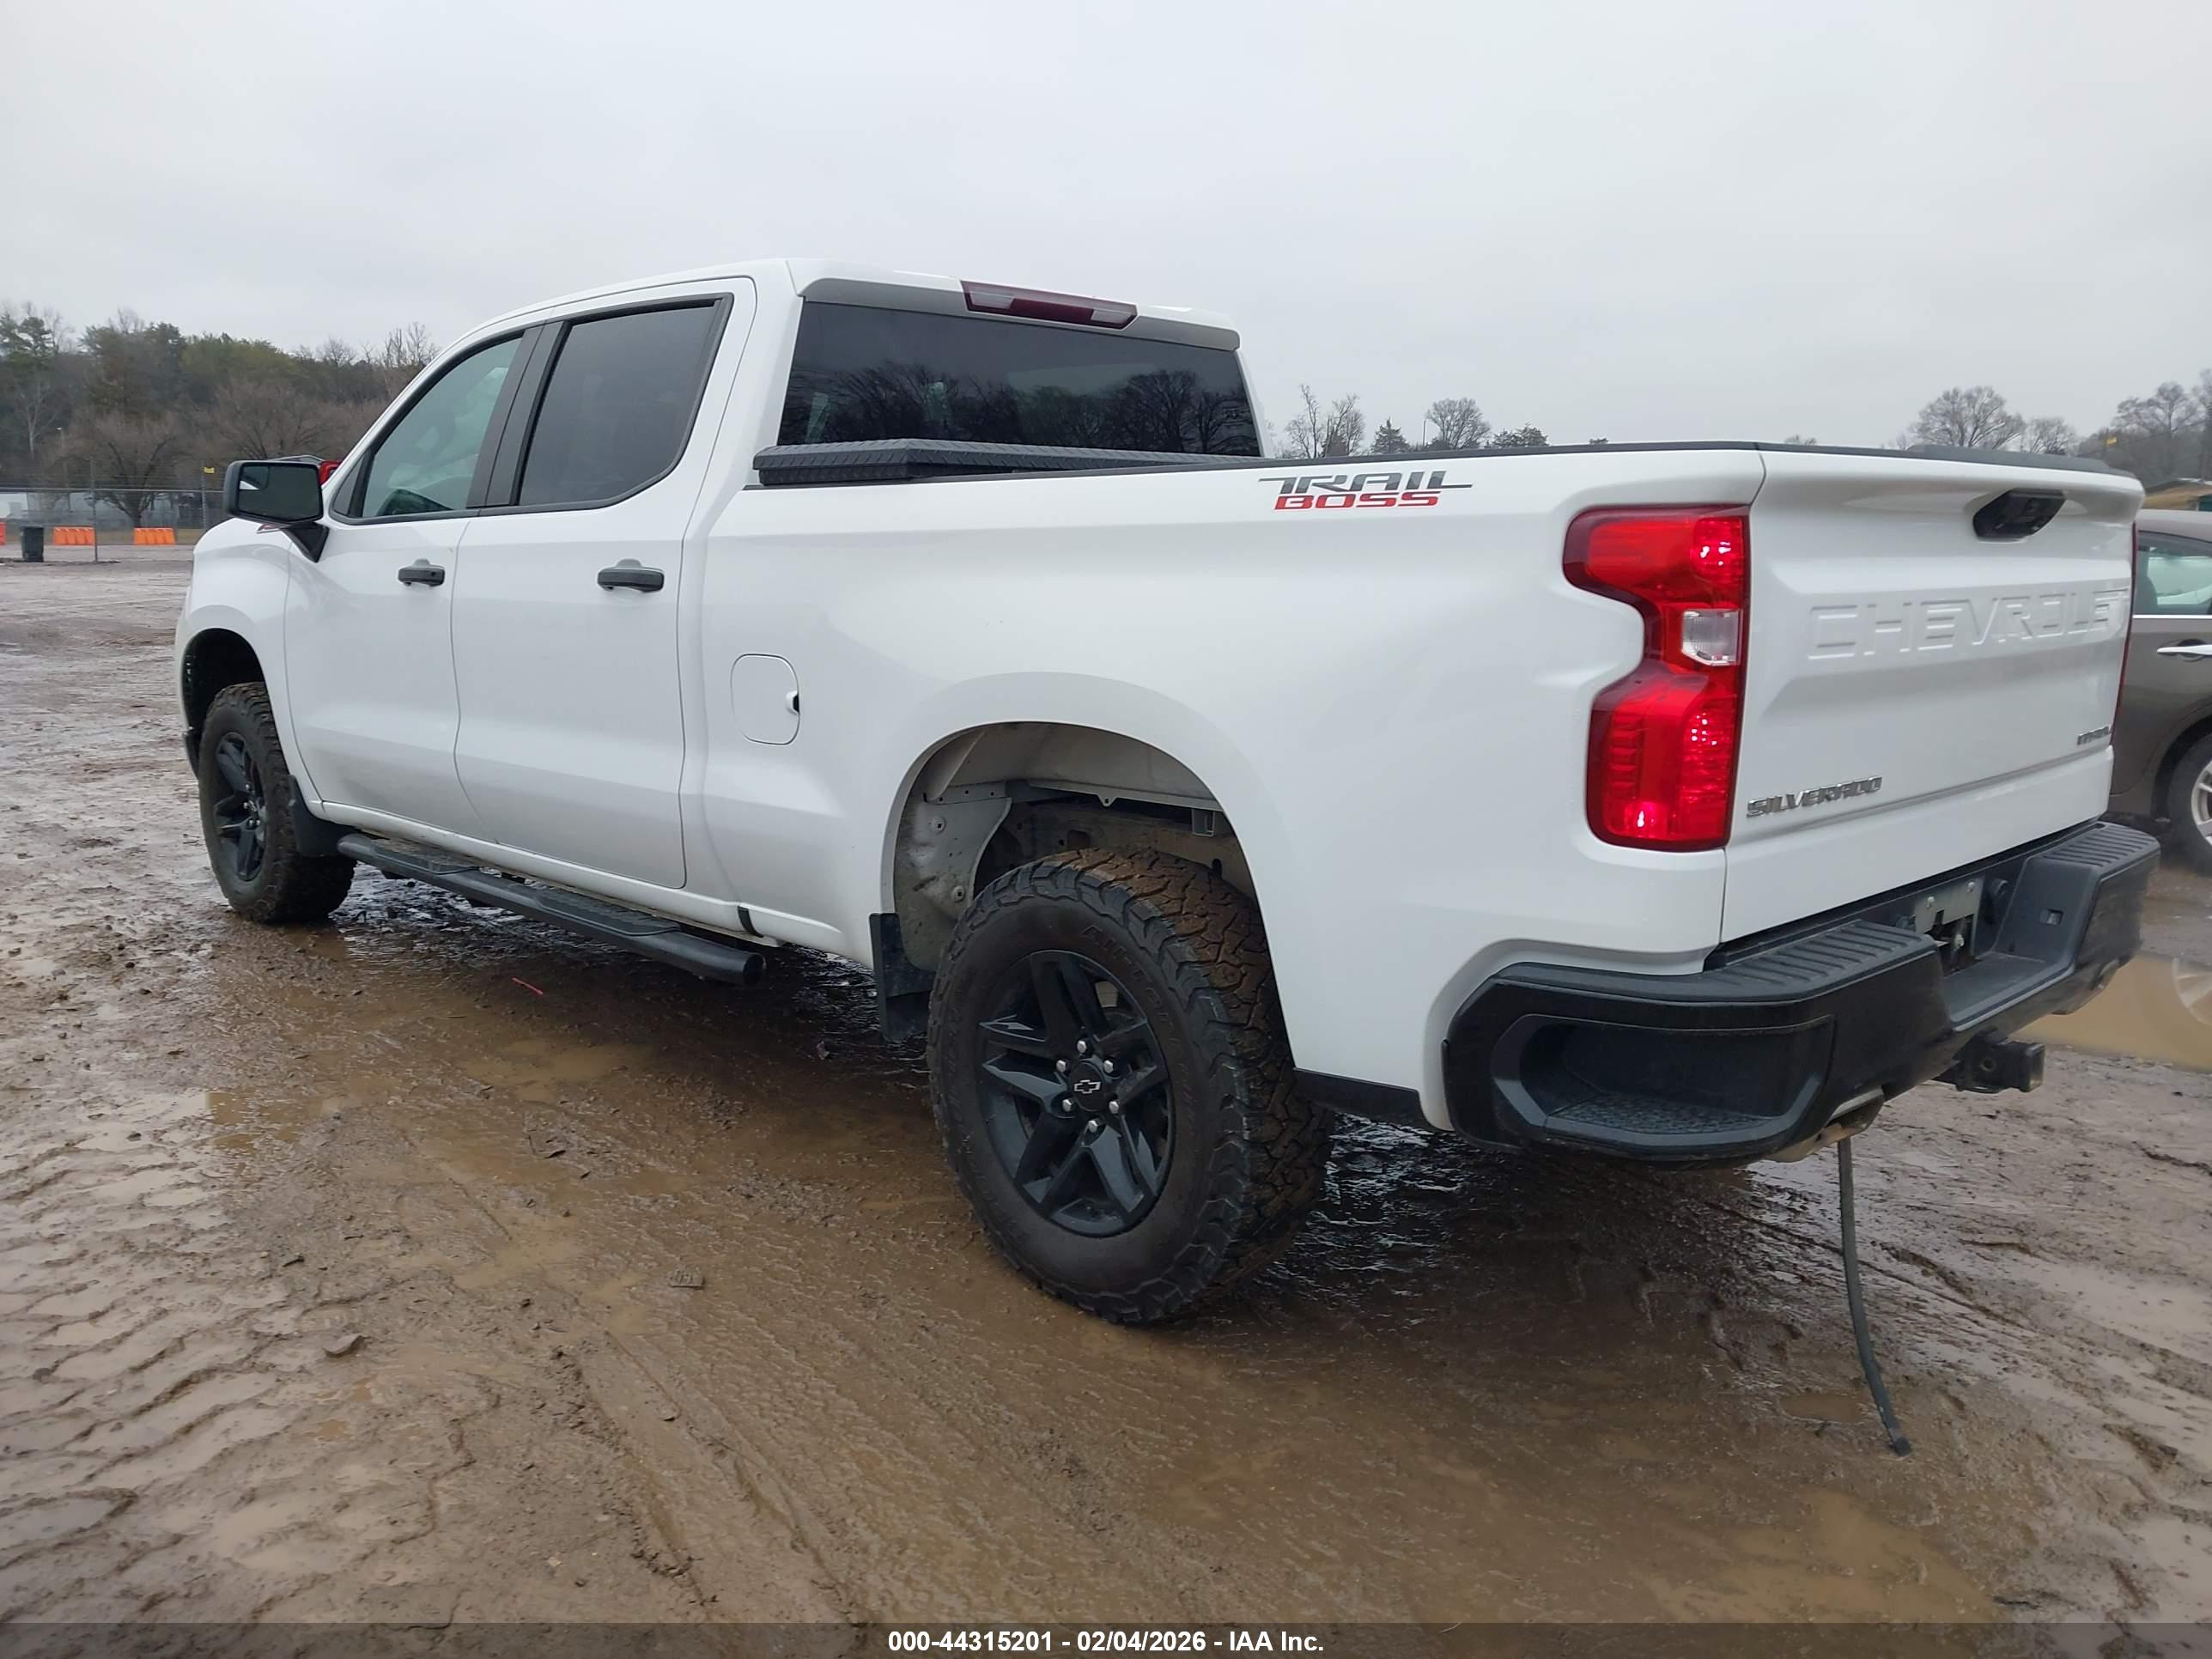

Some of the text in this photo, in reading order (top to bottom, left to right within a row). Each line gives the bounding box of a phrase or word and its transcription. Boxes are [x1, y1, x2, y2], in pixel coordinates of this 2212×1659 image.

[1258, 471, 1473, 494] TRAIL
[1274, 490, 1441, 510] BOSS
[1747, 776, 1883, 817] SILVERADO
